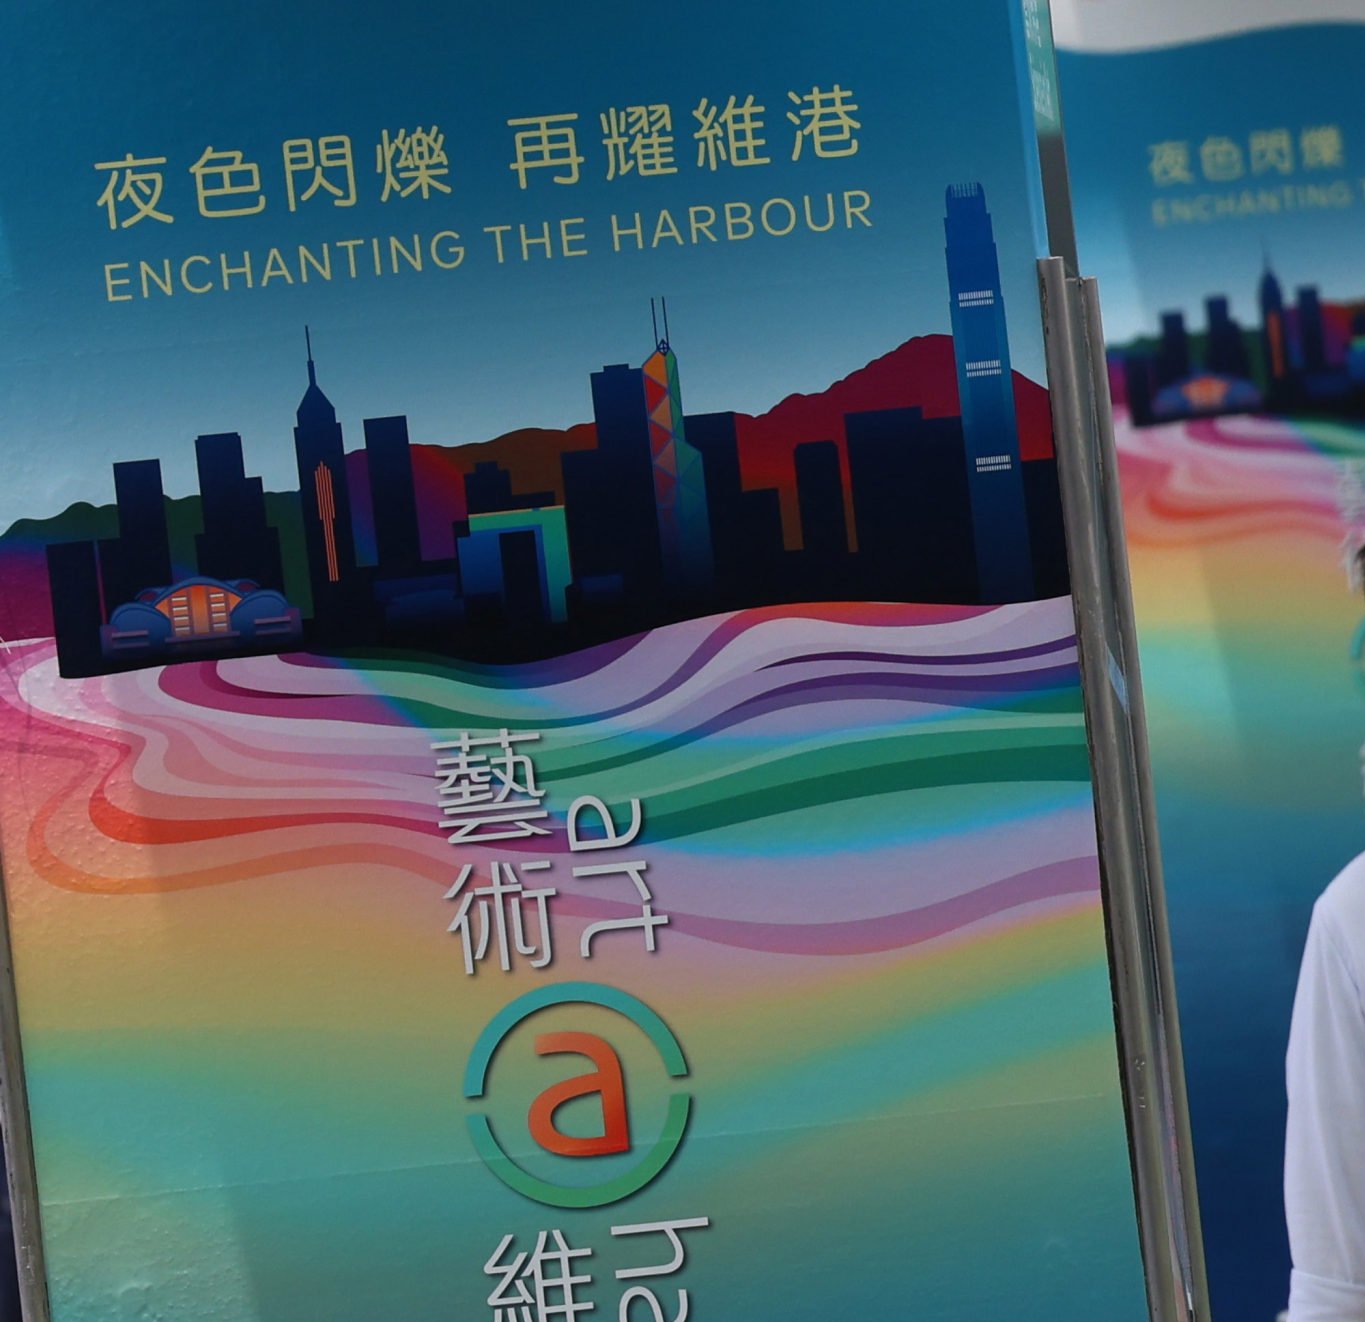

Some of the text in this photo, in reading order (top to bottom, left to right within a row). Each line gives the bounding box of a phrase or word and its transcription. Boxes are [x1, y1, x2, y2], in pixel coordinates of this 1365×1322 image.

[94, 84, 862, 230] 夜色閃爍 再耀維港
[1151, 180, 1353, 227] ENCHANTING
[104, 190, 873, 302] ENCHANTING THE HARBOUR
[430, 728, 556, 974] 藝術
[567, 795, 669, 957] art
